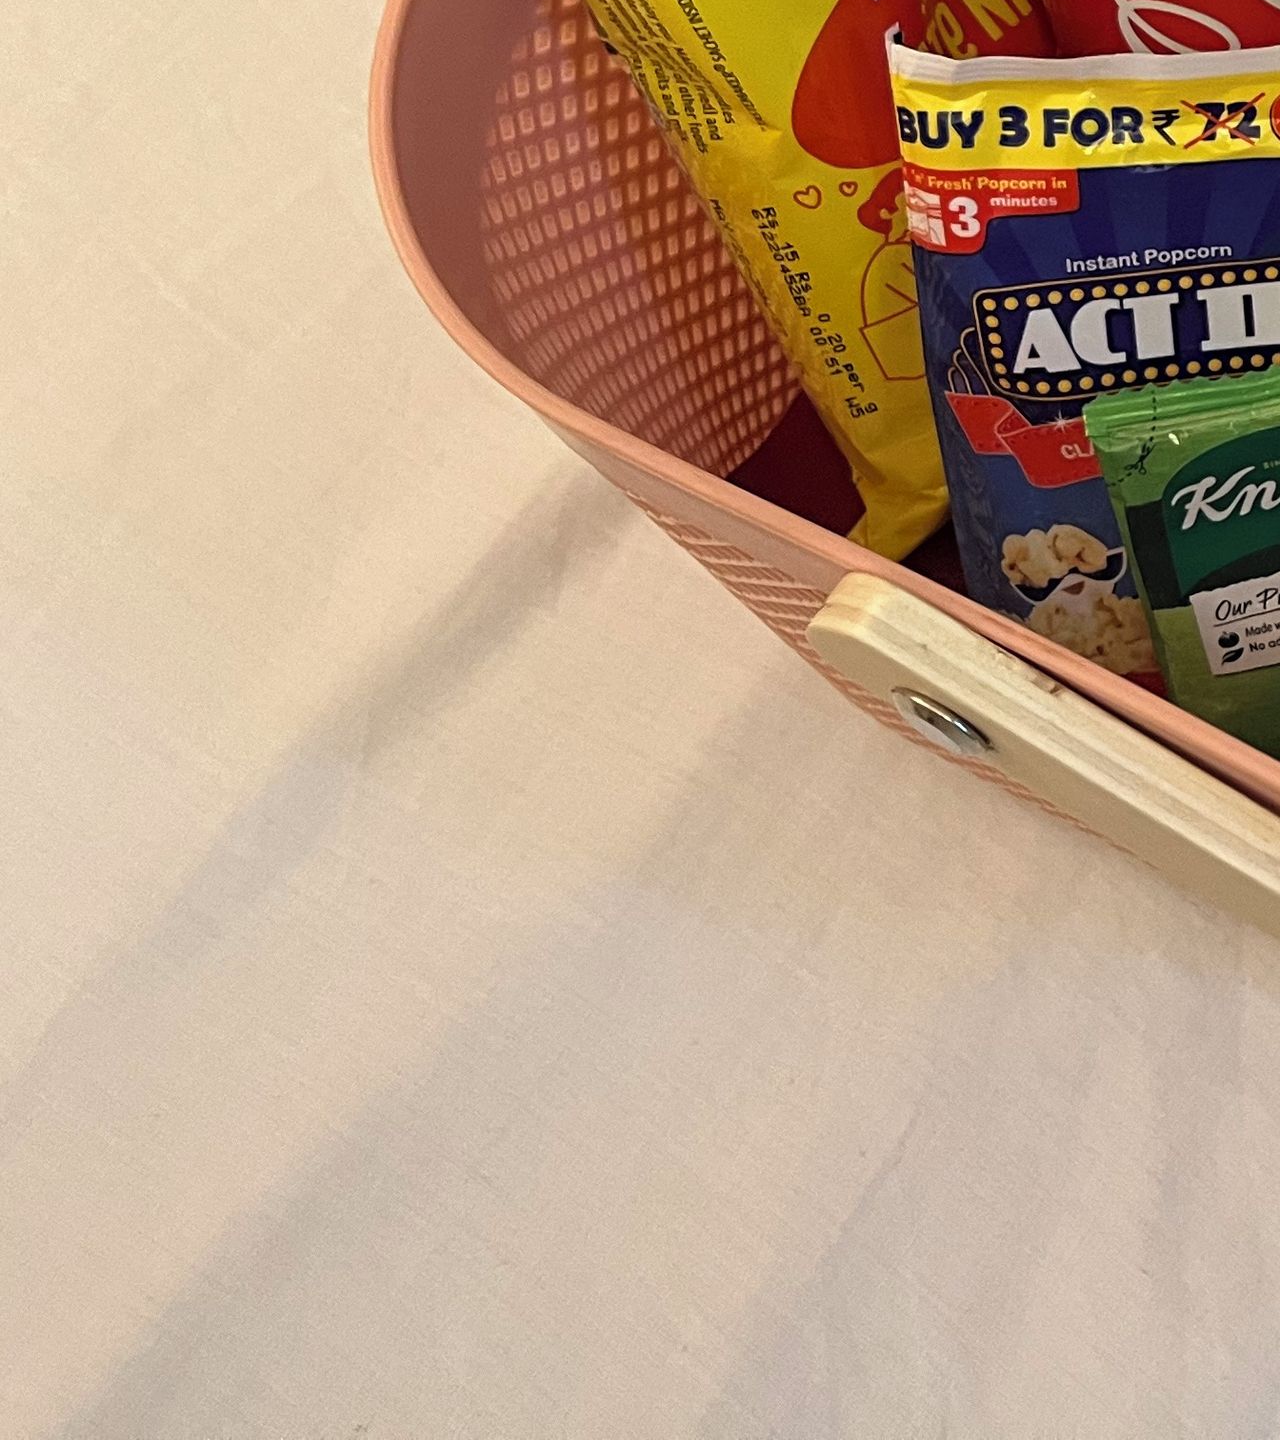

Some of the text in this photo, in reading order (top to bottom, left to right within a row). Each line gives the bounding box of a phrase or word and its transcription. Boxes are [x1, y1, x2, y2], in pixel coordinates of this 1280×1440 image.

[897, 106, 984, 148] BUY
[998, 106, 1030, 147] 3
[1044, 106, 1144, 147] FOR
[977, 176, 1047, 192] Popcorn
[1051, 177, 1067, 190] in
[989, 194, 1058, 208] minutes
[949, 196, 981, 238] 3
[1065, 243, 1233, 273] Instant Popcorn
[780, 241, 799, 262] 15
[842, 363, 865, 393] per
[866, 403, 878, 415] g
[1013, 292, 1180, 374] ACT
[1215, 599, 1252, 621] Our
[1245, 622, 1273, 638] Made
[1249, 639, 1266, 653] No
